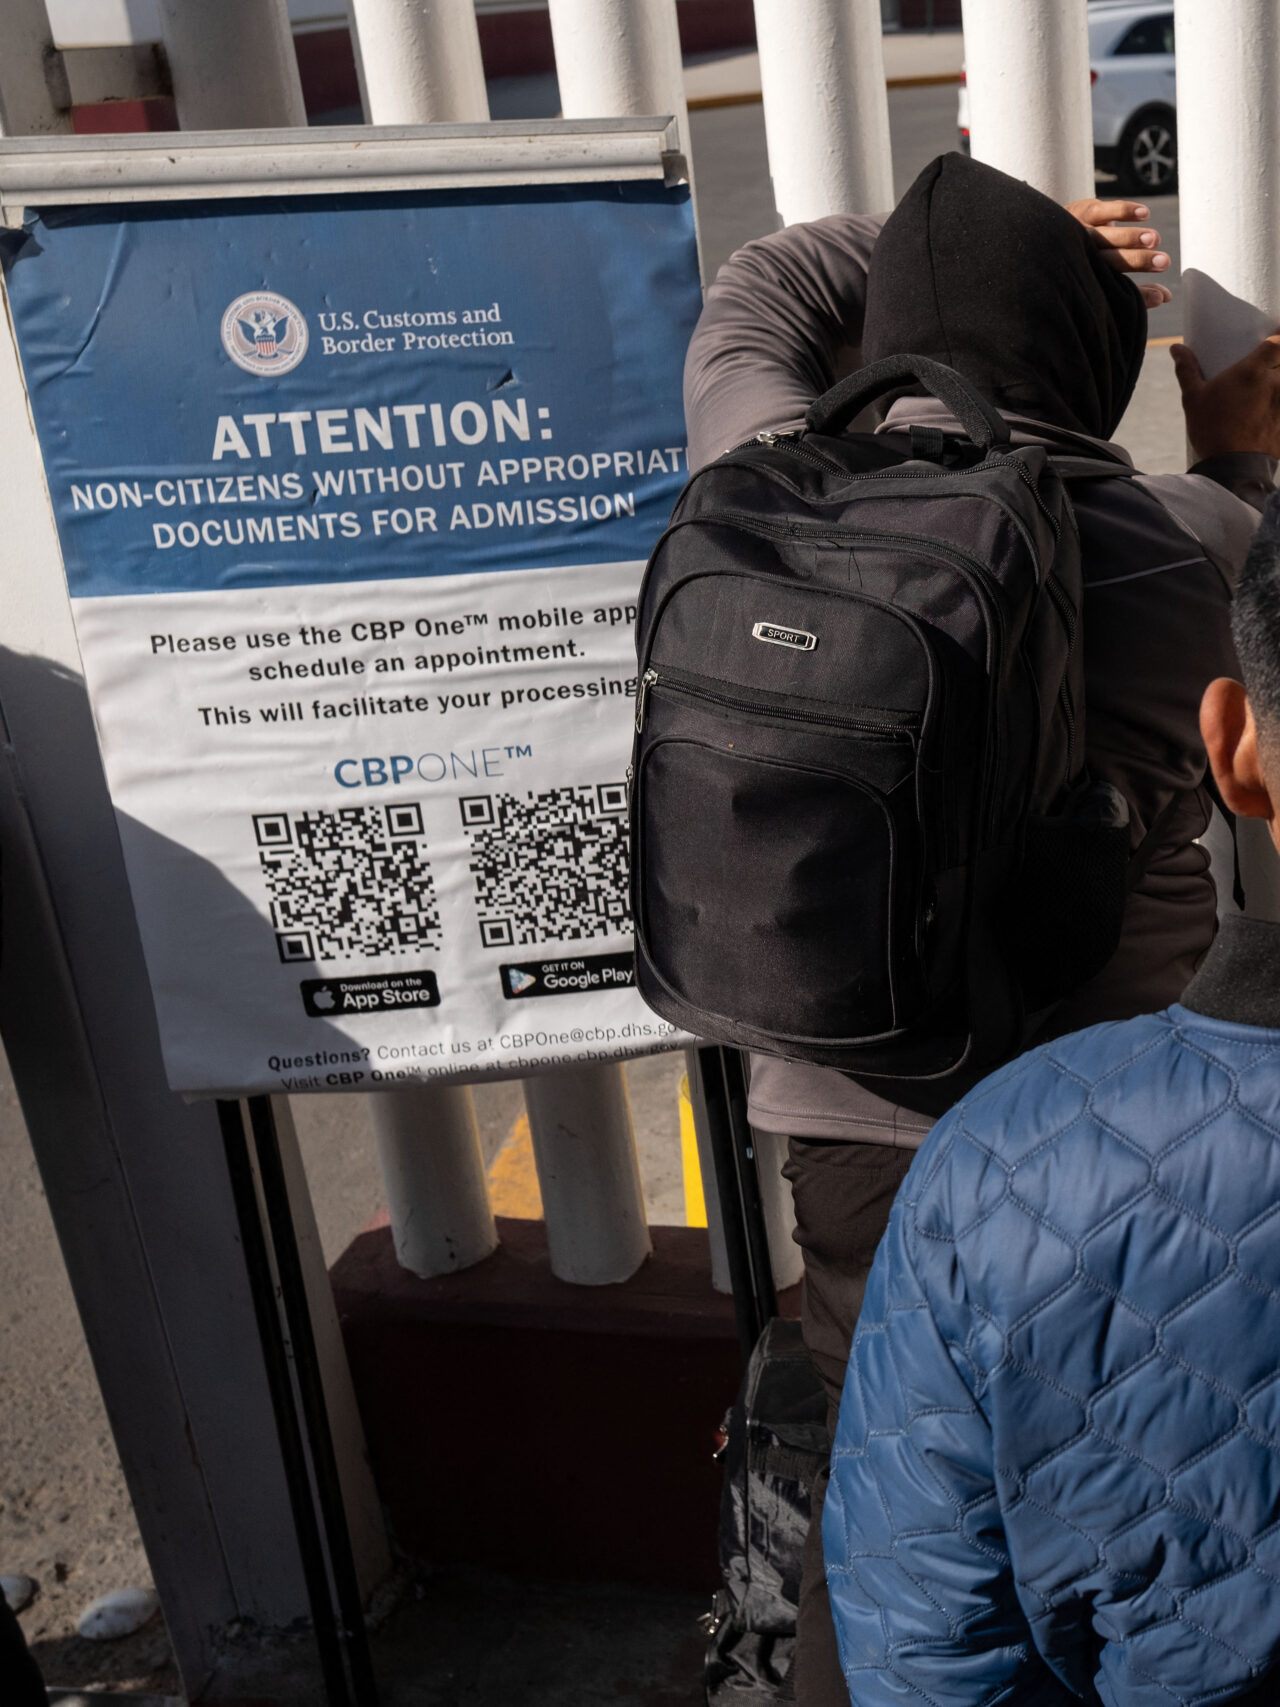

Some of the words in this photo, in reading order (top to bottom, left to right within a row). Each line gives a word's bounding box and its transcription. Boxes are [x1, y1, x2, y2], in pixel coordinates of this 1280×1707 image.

[318, 312, 359, 331] U.S.
[363, 310, 457, 329] Customs
[462, 302, 502, 324] and
[321, 333, 396, 355] Border
[402, 328, 515, 350] Protection
[212, 398, 553, 460] ATTENTION:
[70, 472, 304, 511] NON-CITIZENS
[312, 461, 465, 497] WITHOUT
[477, 447, 689, 486] APPROPRIAT
[152, 512, 362, 549] DOCUMENTS
[372, 506, 438, 536] FOR
[450, 492, 636, 531] ADMISSION
[150, 634, 237, 654] Please
[246, 631, 291, 649] use
[299, 626, 342, 646] the
[351, 620, 405, 642] CBP
[498, 607, 584, 631] mobile
[593, 605, 637, 626] app
[767, 628, 800, 643] SPORT
[249, 657, 366, 681] schedule
[374, 657, 405, 674] an
[414, 639, 586, 673] appointment.
[198, 706, 251, 726] This
[259, 701, 304, 723] will
[312, 694, 429, 720] facilitate
[437, 691, 491, 714] your
[501, 677, 637, 709] processing
[542, 963, 559, 973] GET
[561, 962, 570, 971] IT
[570, 961, 585, 970] ON
[543, 970, 600, 989] Google
[602, 968, 633, 984] Play
[340, 980, 388, 992] Download
[390, 979, 404, 988] on
[405, 978, 422, 987] the
[343, 992, 380, 1009] App
[382, 989, 430, 1004] Store
[268, 1047, 371, 1072] Questions?
[377, 1042, 444, 1060] Contact
[451, 1040, 471, 1054] us
[477, 1037, 493, 1052] at
[500, 1022, 684, 1050] CBPOne@cbp.dhs.go
[281, 1074, 320, 1090] Visit
[326, 1070, 364, 1086] CBP
